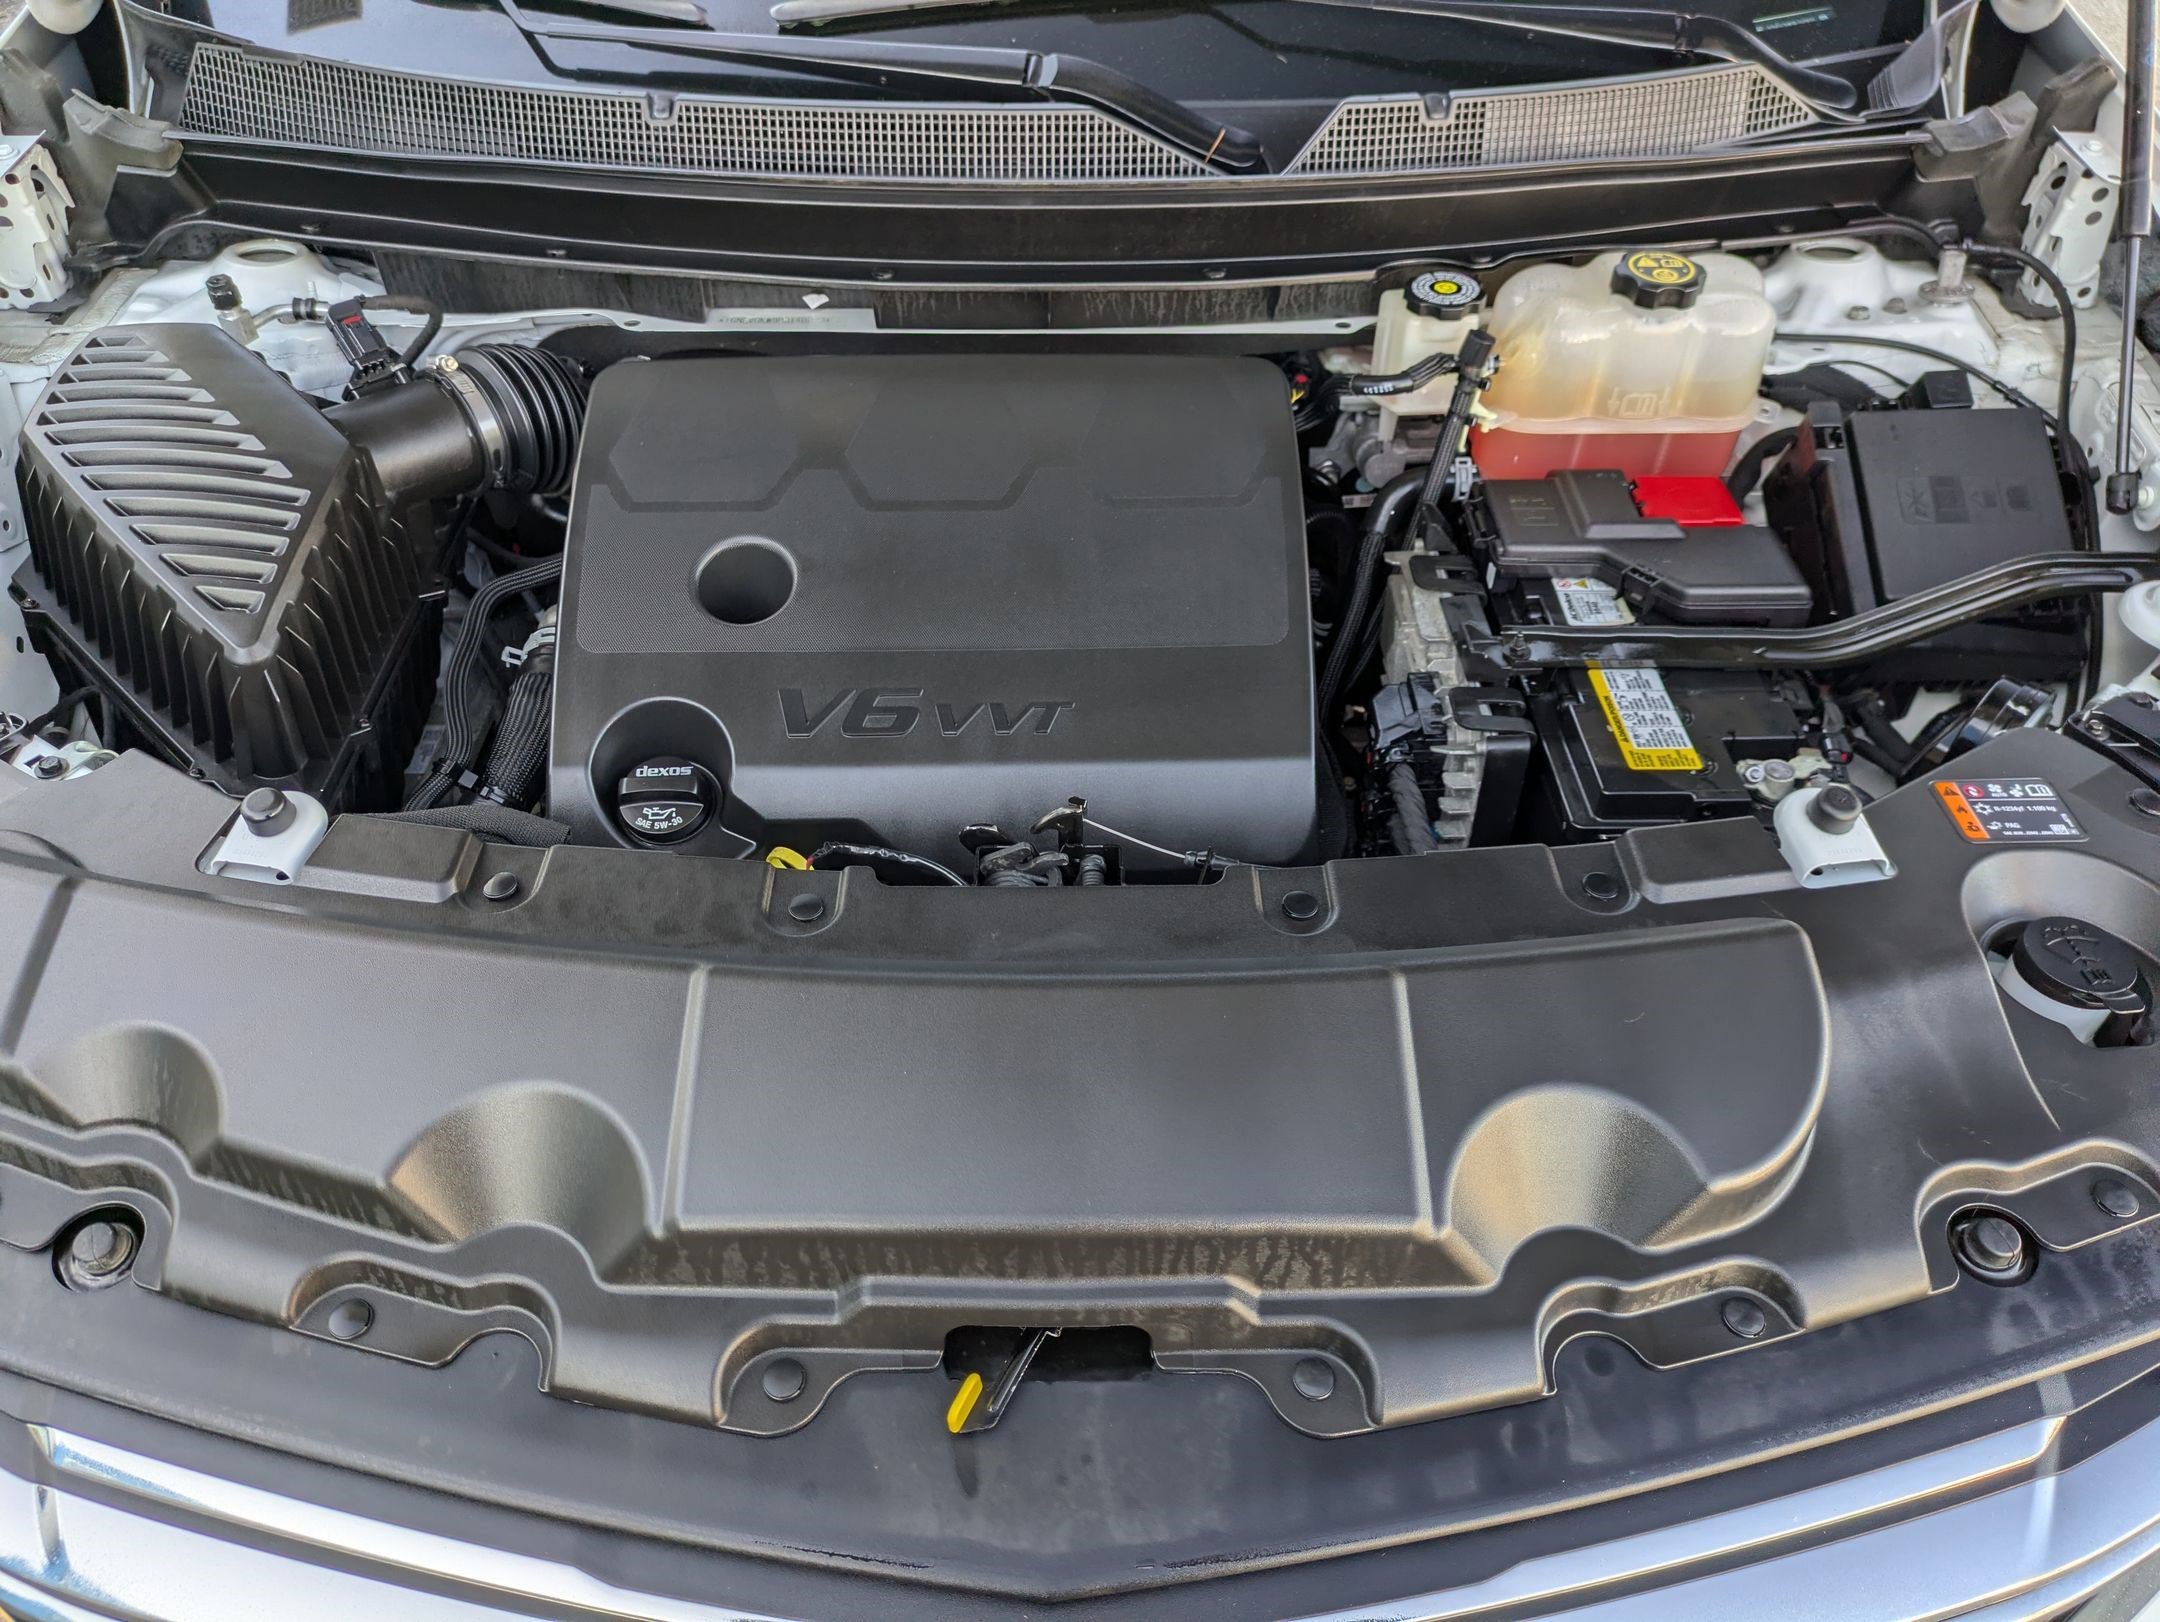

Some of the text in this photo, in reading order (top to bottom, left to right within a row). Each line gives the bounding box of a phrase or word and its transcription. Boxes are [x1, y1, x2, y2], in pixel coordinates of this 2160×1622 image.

[778, 688, 1076, 739] V6 VVT
[635, 765, 694, 777] dexos
[635, 816, 683, 829] SAE 5W-30
